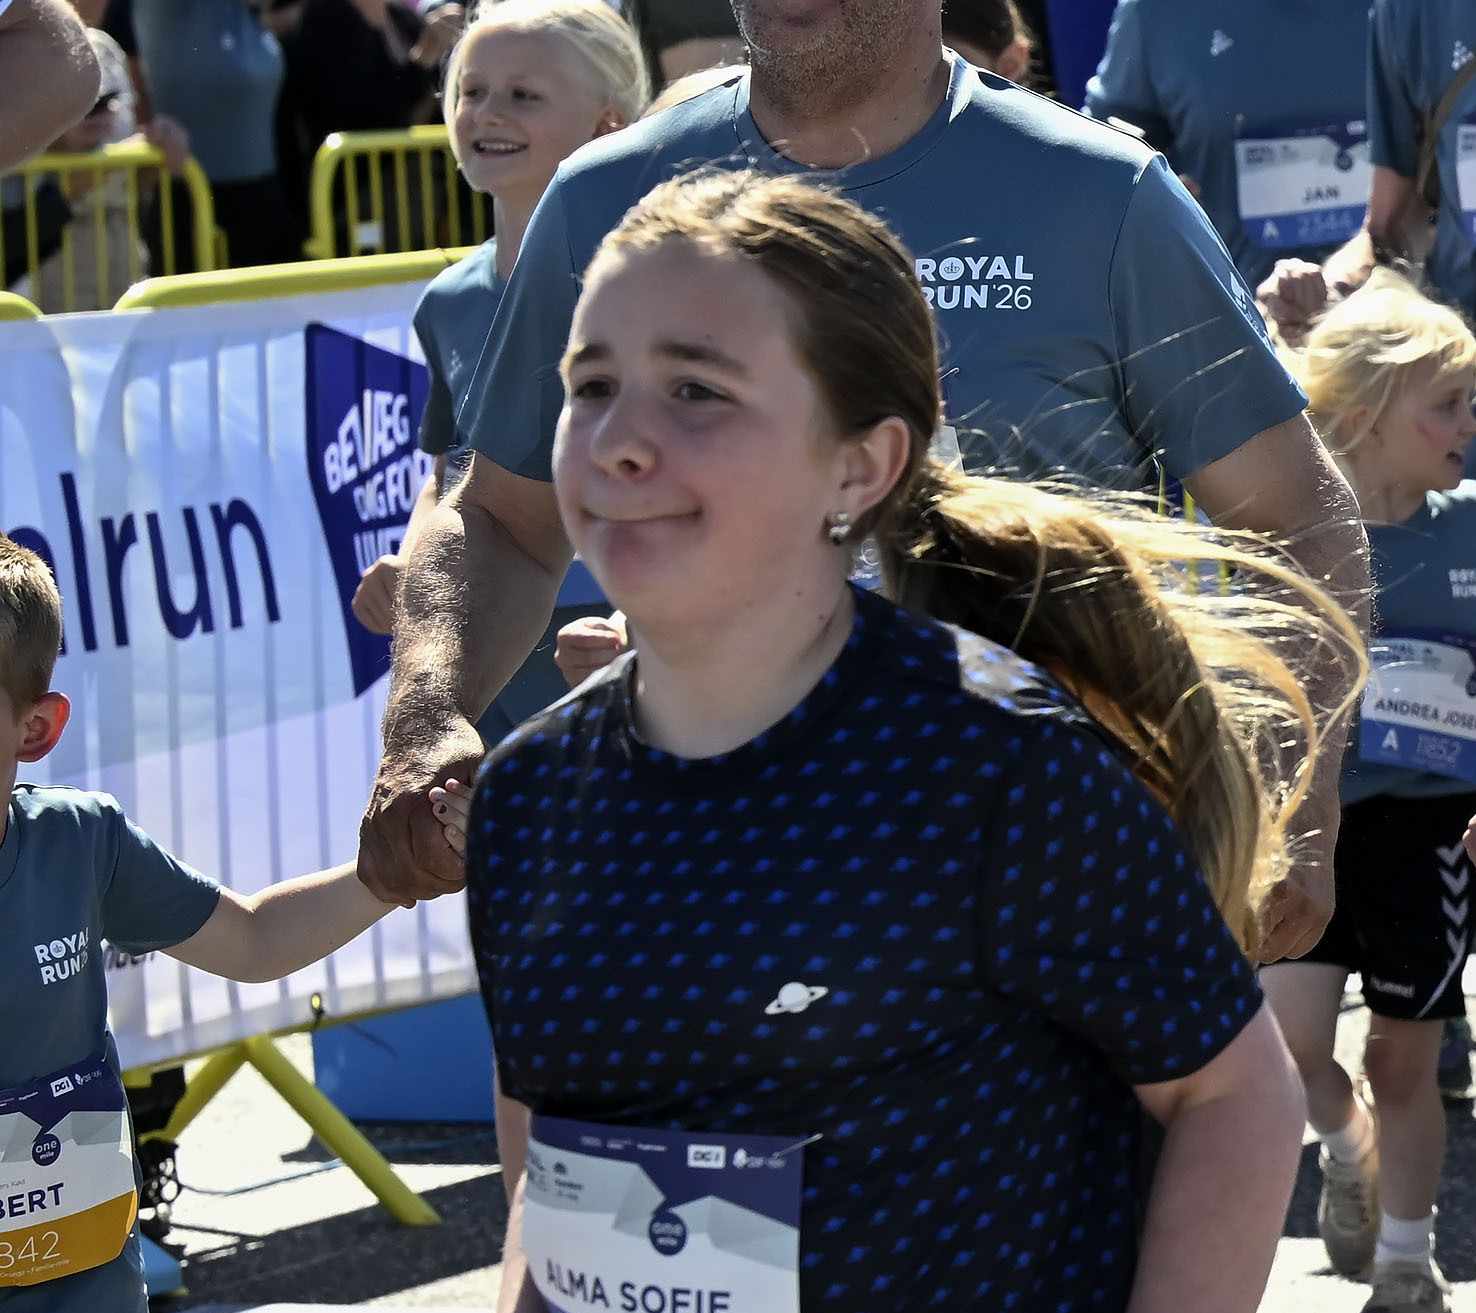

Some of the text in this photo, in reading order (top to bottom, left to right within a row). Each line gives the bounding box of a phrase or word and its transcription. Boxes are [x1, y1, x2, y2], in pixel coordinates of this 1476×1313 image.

[915, 255, 1034, 281] ROYAL
[1375, 697, 1439, 721] ANDREA
[1381, 728, 1399, 752] A
[54, 1081, 71, 1093] DGI
[35, 1139, 58, 1154] one
[546, 1258, 610, 1308] ALMA
